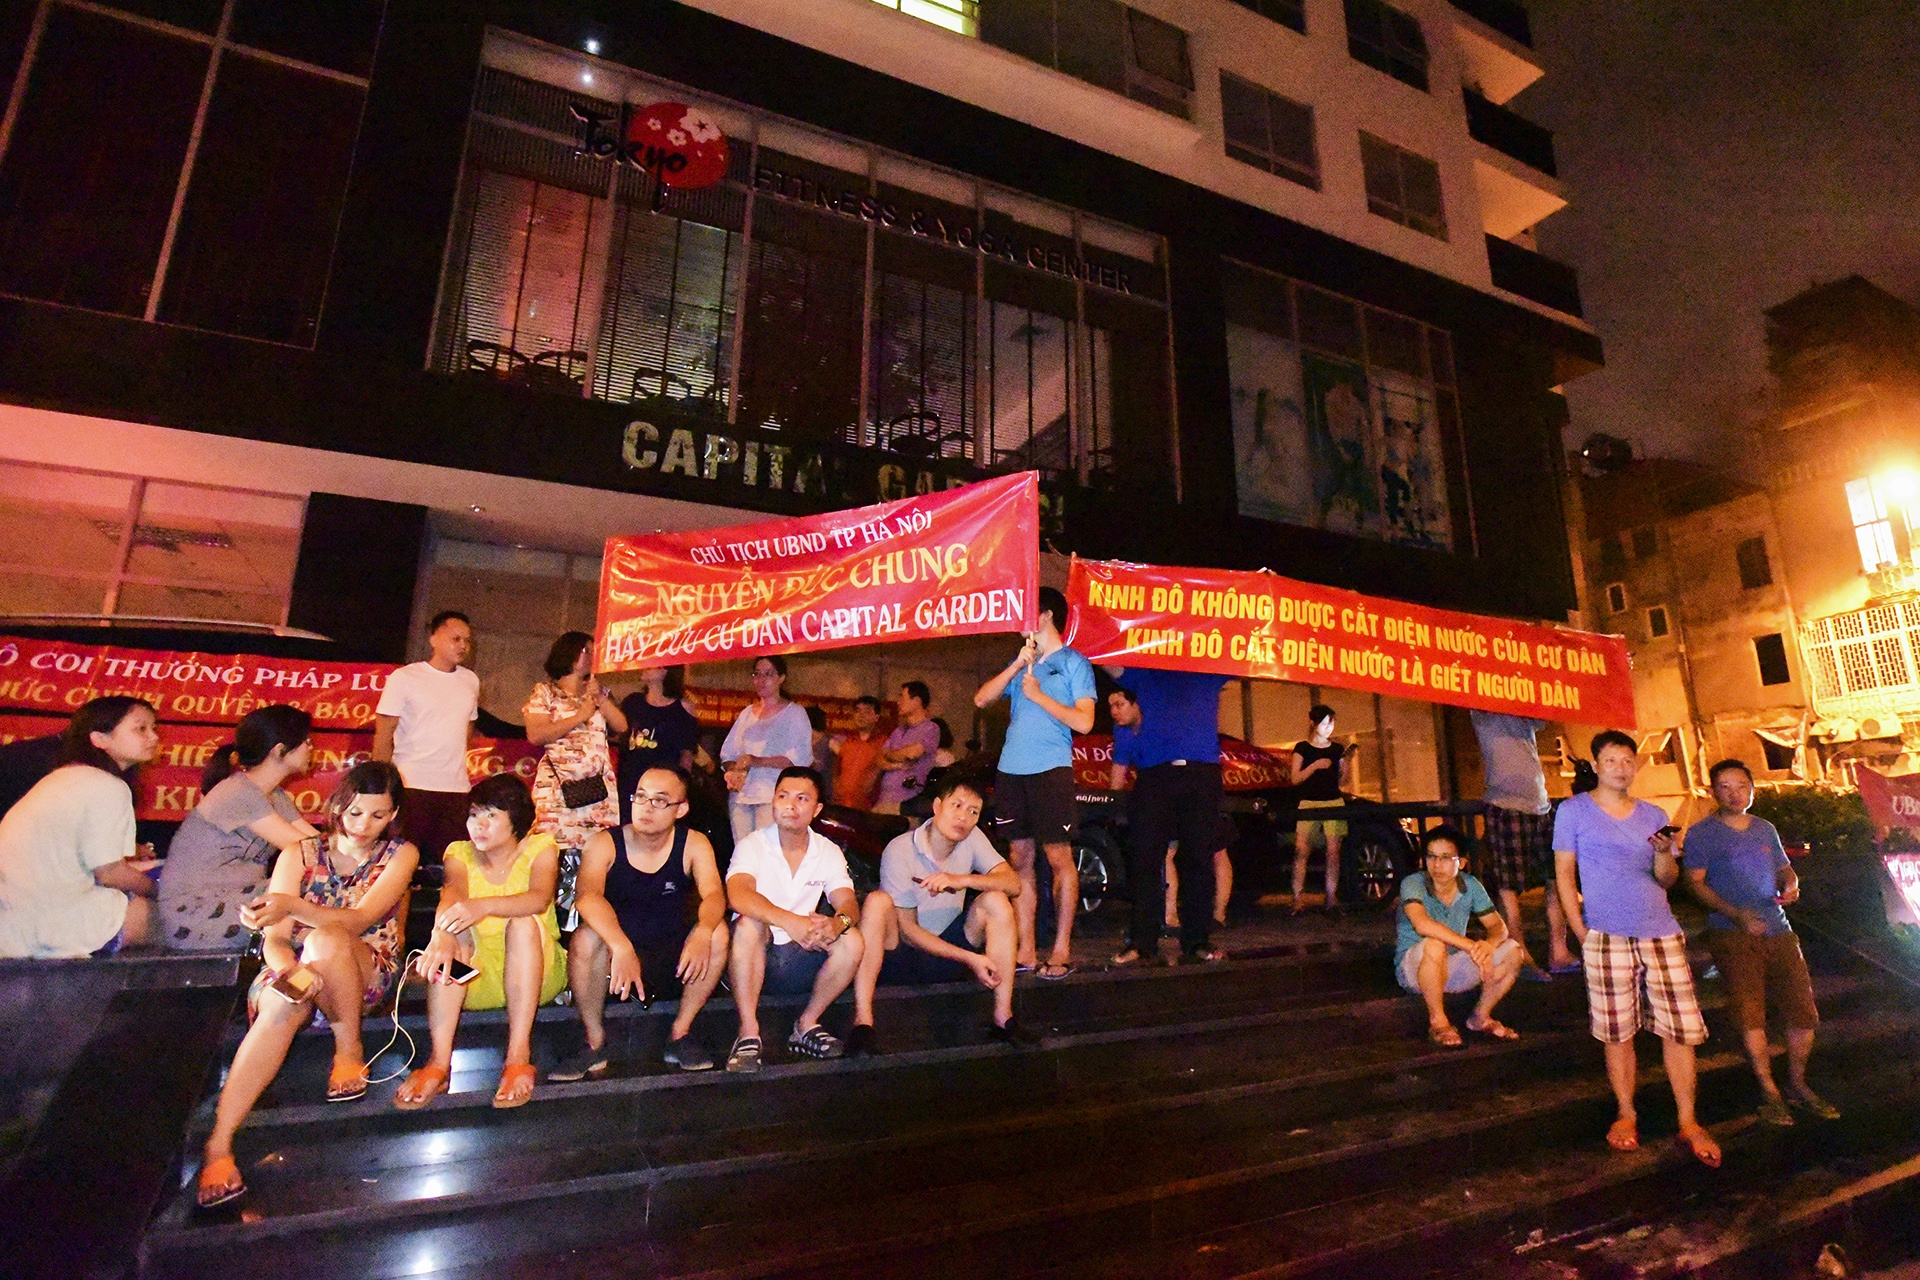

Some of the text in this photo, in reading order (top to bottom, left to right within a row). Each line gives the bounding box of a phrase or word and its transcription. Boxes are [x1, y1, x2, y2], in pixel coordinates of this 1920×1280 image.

[756, 169, 898, 227] FITNESS
[936, 216, 1015, 262] YOGA
[1026, 246, 1131, 295] CENTER
[621, 420, 850, 498] CAPITA
[690, 508, 933, 566] CHỦ TỊCH UBND TP HÀ NỘI
[655, 543, 968, 617] NGUYỄN ĐỨC CHUNG
[604, 589, 1024, 664] HÃY CỨU CƯ DÂN CAPITAL GARDEN
[1088, 580, 1607, 676] KINH ĐÔ KHÔNG ĐƯỢC CẮT ĐIỆN NƯỚC CỦA CƯ DÂN
[30, 652, 94, 674] COI
[104, 658, 245, 685] THƯỜNG
[253, 667, 342, 689] PHÁP
[350, 673, 387, 692] LU
[1126, 626, 1581, 710] KINH ĐÔ CẮT ĐIỆN NƯỚC LÀ GIẾT NGƯỜI DÂN
[154, 736, 224, 767] HIẾ
[153, 785, 198, 811] KI
